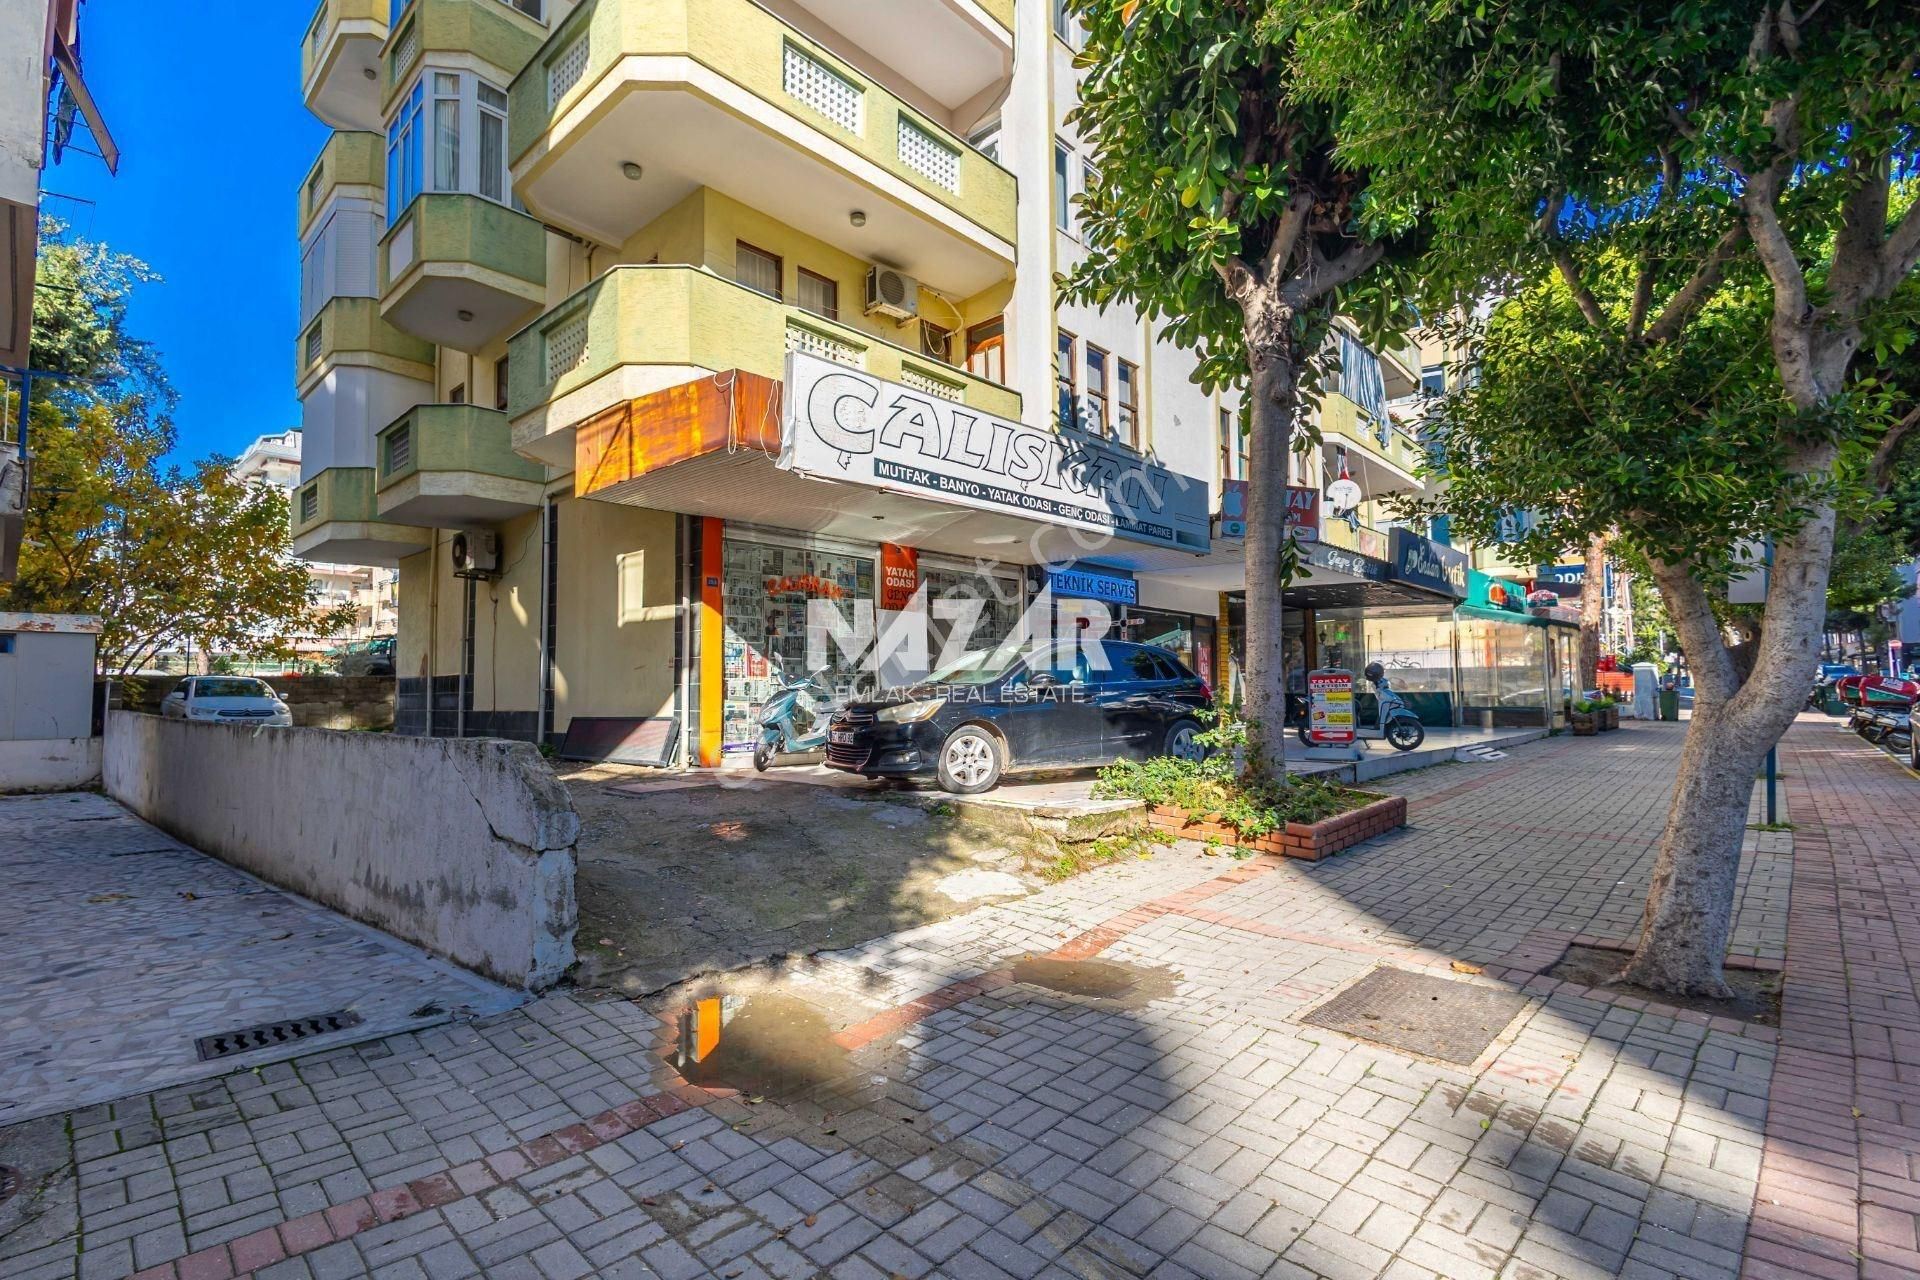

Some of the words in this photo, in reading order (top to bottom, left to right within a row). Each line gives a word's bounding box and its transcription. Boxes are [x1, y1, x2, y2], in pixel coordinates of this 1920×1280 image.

[807, 373, 1169, 514] ÇALIŞKAN
[878, 461, 931, 486] MUTFAK
[939, 475, 980, 496] BANYO
[987, 487, 1020, 506] YATAK
[1021, 494, 1052, 512] ODASI
[1058, 503, 1084, 522] GENÇ
[1084, 509, 1110, 526] ODASI
[1148, 524, 1172, 539] PARKE
[885, 565, 916, 578] YATAK
[885, 576, 915, 588] ODASI
[1048, 571, 1095, 593] TEKNİK
[1097, 580, 1136, 600] SERVİS
